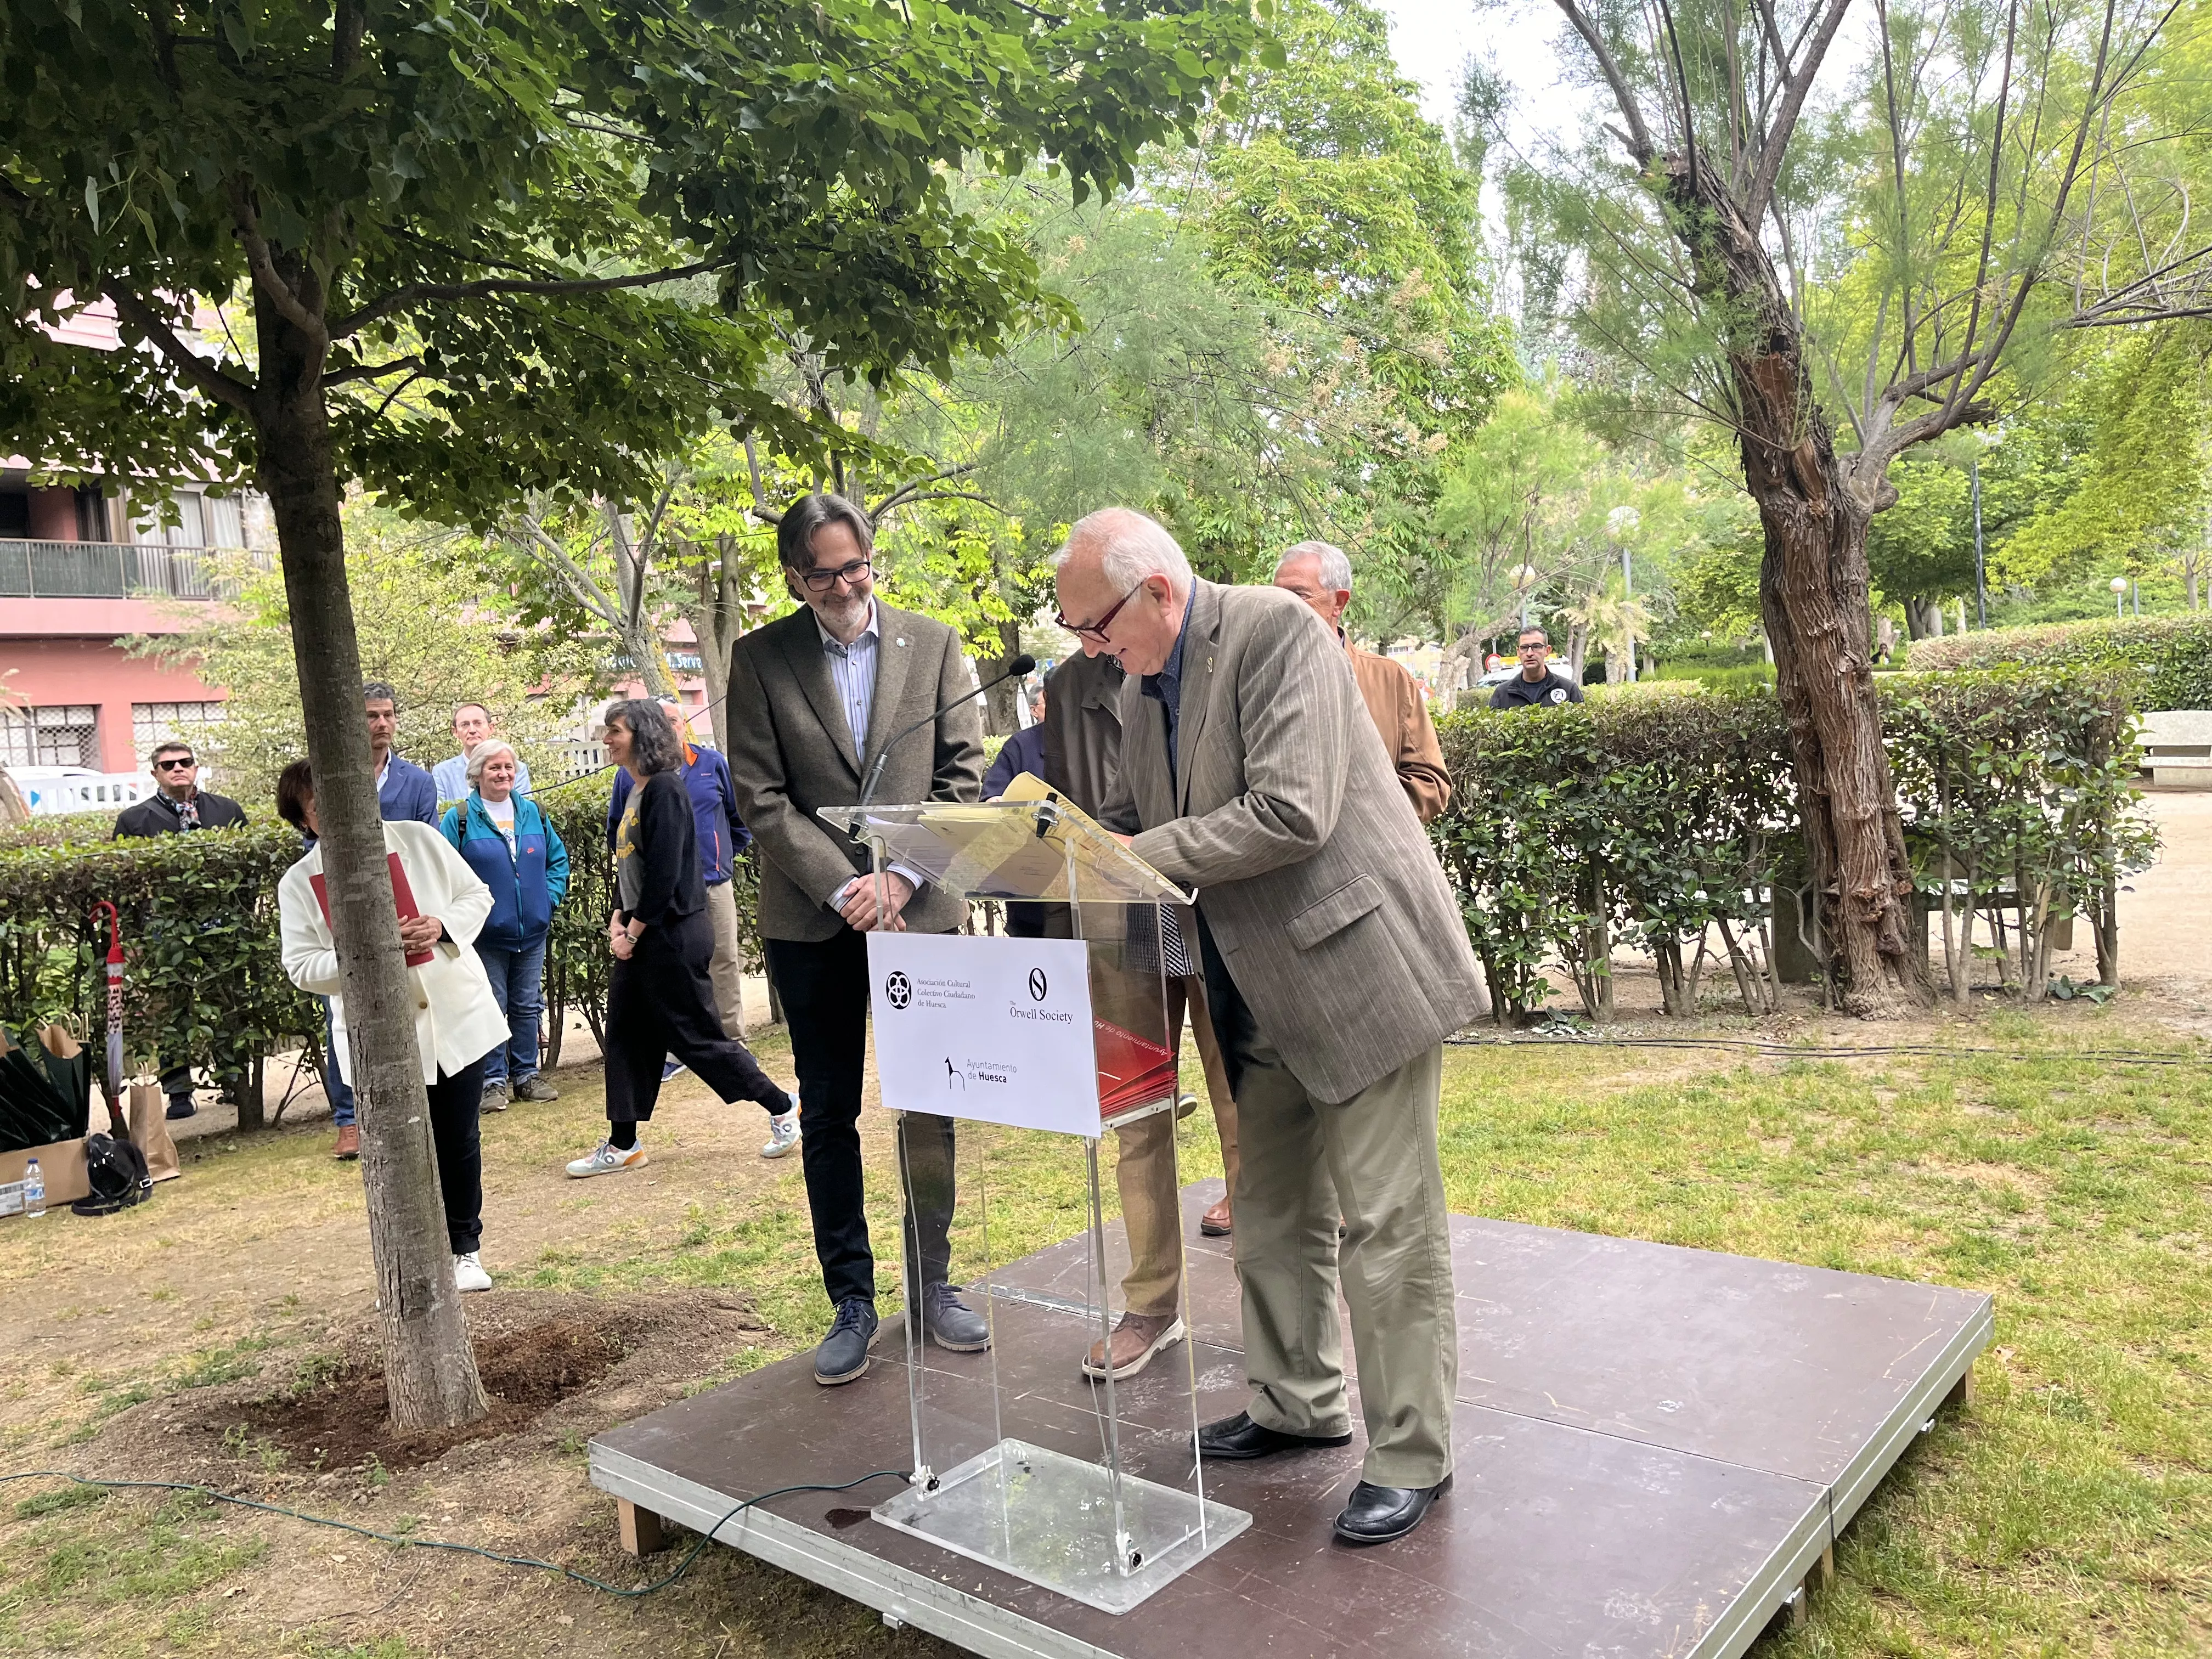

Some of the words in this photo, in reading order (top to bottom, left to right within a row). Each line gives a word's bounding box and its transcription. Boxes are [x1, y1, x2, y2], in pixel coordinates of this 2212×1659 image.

[675, 652, 703, 669] Serve
[917, 978, 946, 986] Asociación
[947, 979, 970, 988] Cultural
[917, 989, 943, 997] Colectivo
[944, 990, 975, 999] Ciudadano
[1010, 1007, 1037, 1019] Orwell
[1040, 1009, 1073, 1025] Society
[1116, 1031, 1167, 1056] Ayuntamiento
[967, 1058, 1017, 1073] Ayuntamiento
[968, 1071, 977, 1080] de
[979, 1071, 1007, 1083] Huesca
